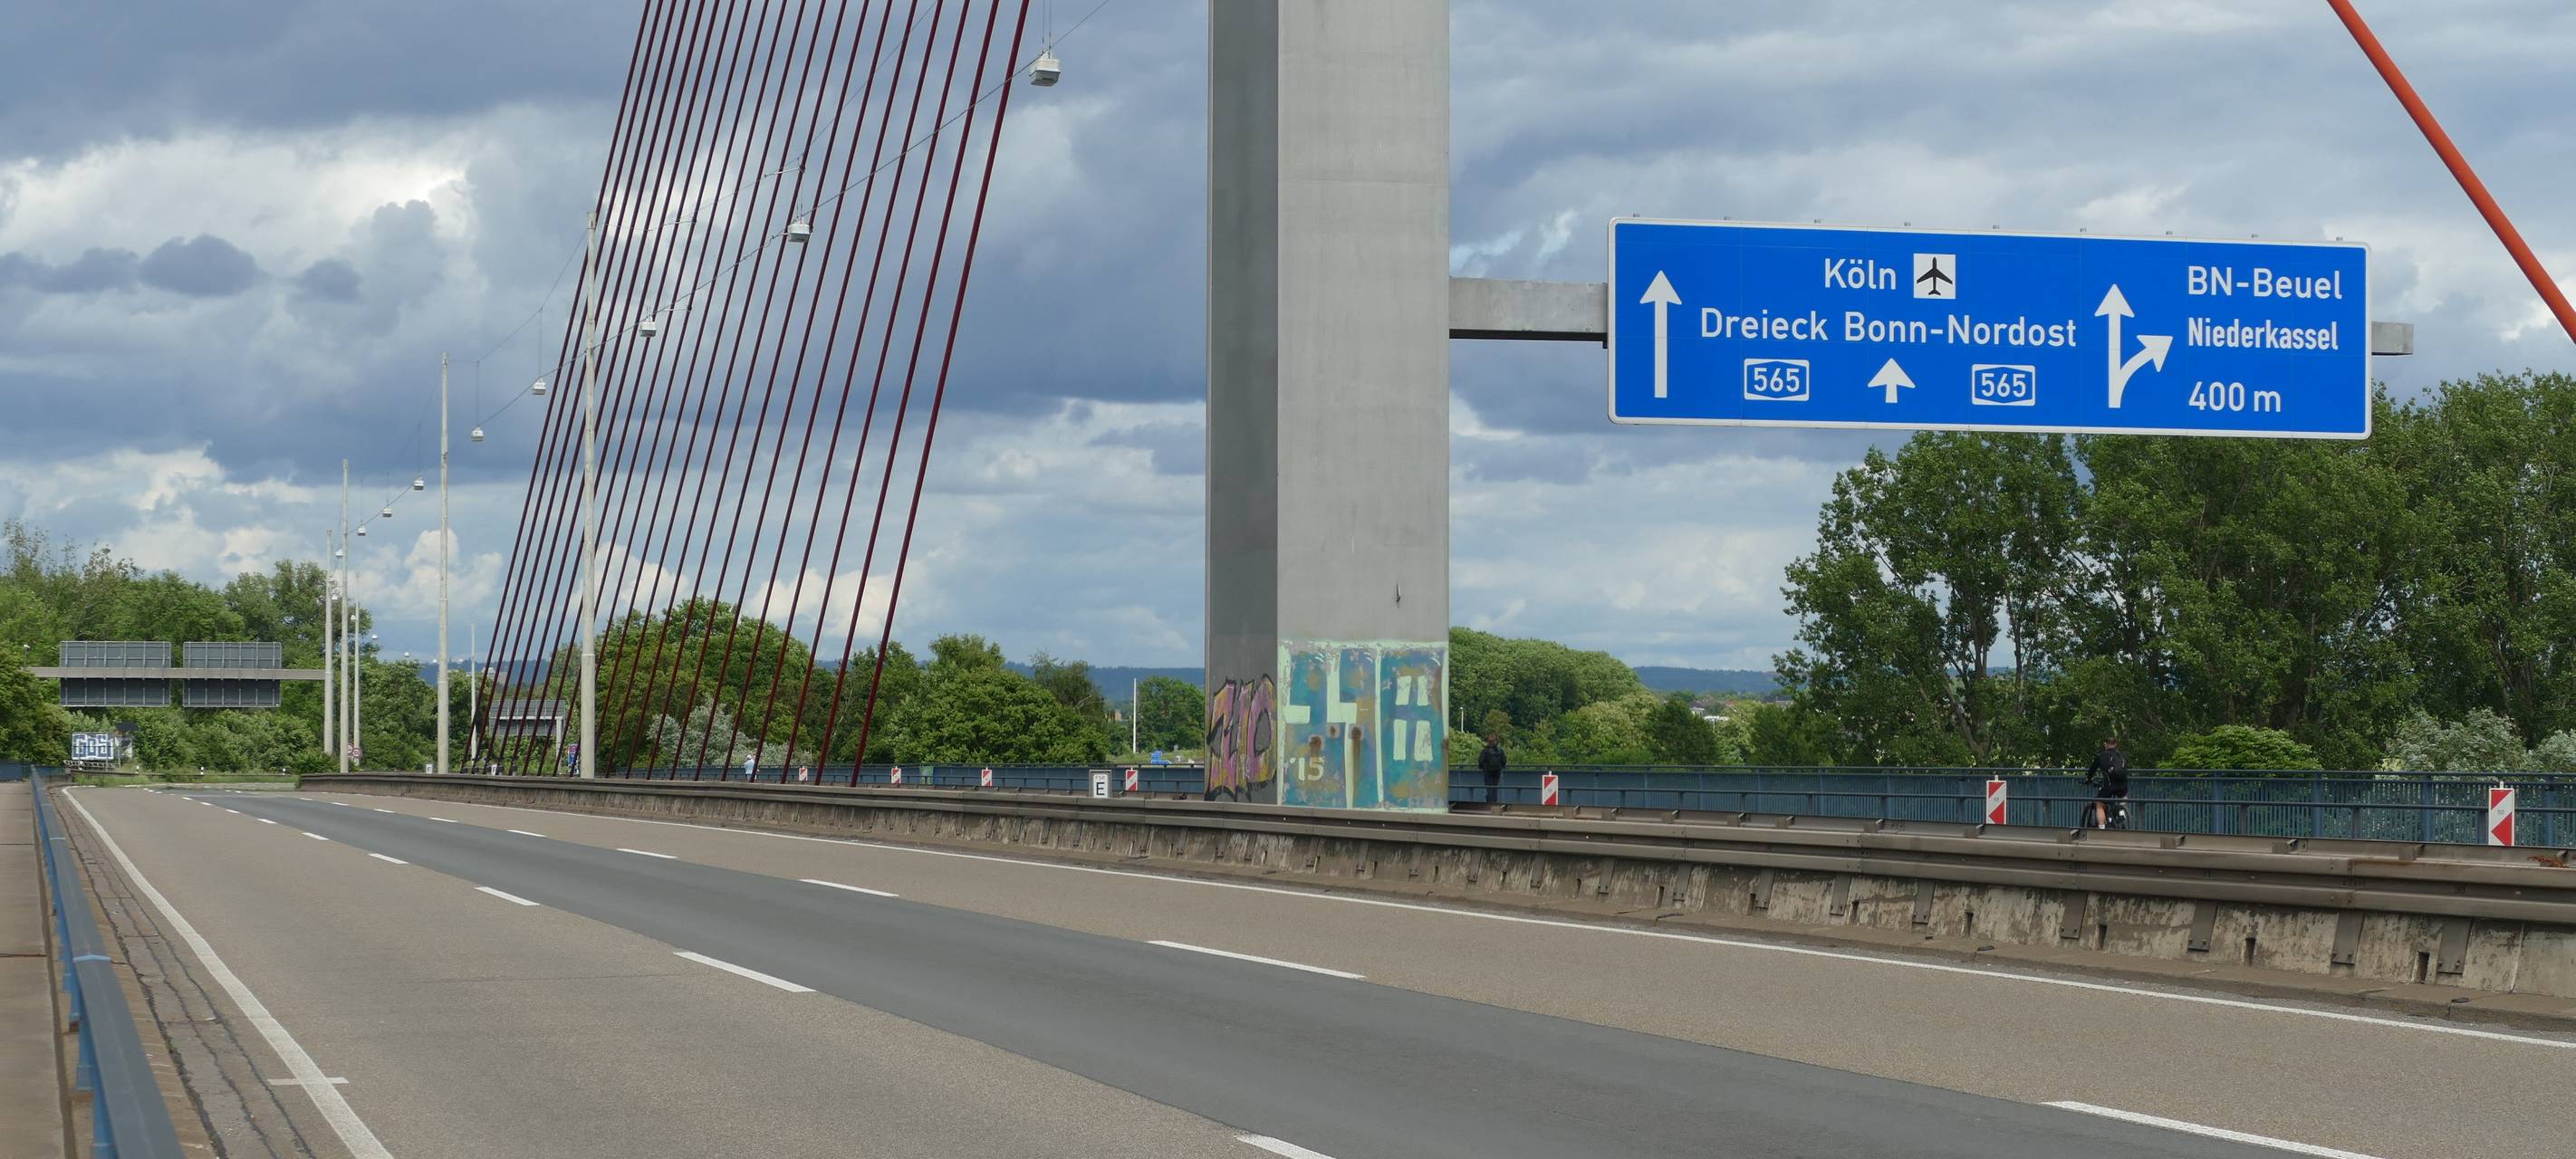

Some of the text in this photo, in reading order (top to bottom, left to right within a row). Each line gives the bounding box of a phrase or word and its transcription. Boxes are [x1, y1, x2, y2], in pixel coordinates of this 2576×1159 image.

[1824, 258, 1897, 291] Köln
[2188, 265, 2342, 300] BN-Beuel
[1701, 307, 2076, 347] Dreieck Bonn-Nordost
[2188, 317, 2339, 350] Niederkassel
[1754, 367, 1800, 392] 565
[1981, 372, 2026, 398] 565
[2188, 381, 2282, 412] 400 m
[1096, 781, 1105, 796] E
